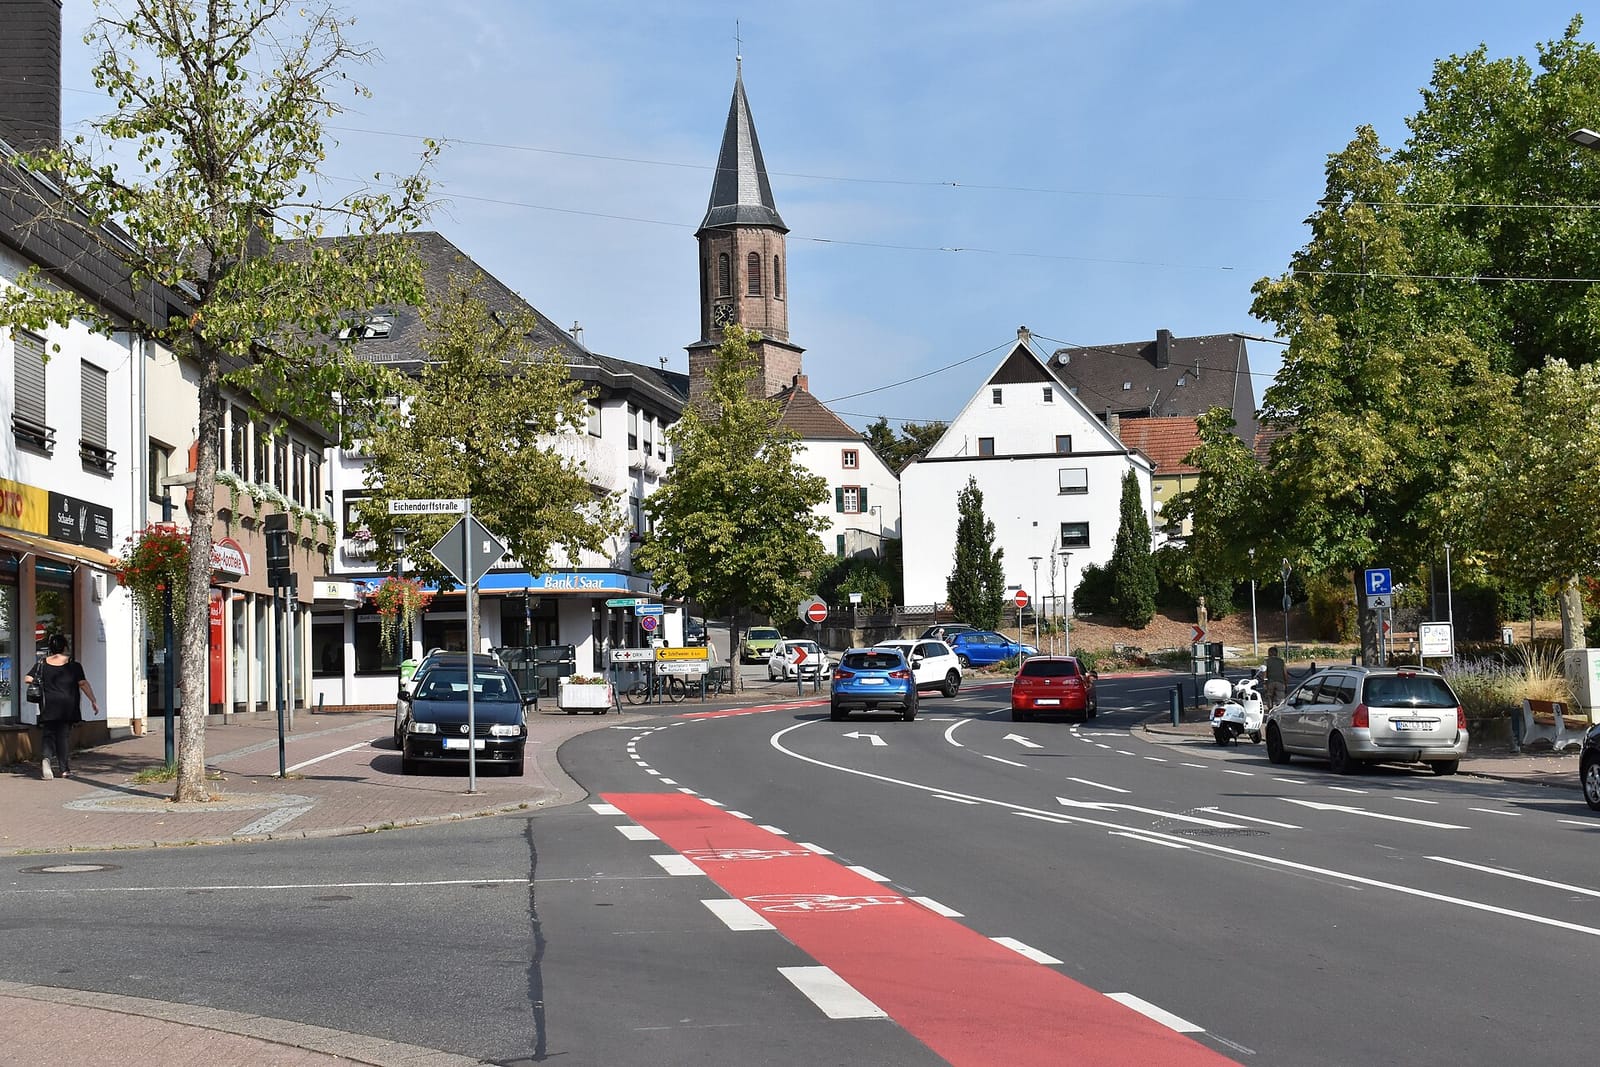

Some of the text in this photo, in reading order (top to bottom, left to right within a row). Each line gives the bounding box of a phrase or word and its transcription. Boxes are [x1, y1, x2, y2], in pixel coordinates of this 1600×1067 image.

[393, 502, 458, 511] Eichendorffstraße
[1371, 573, 1385, 592] P
[328, 585, 337, 593] 1A
